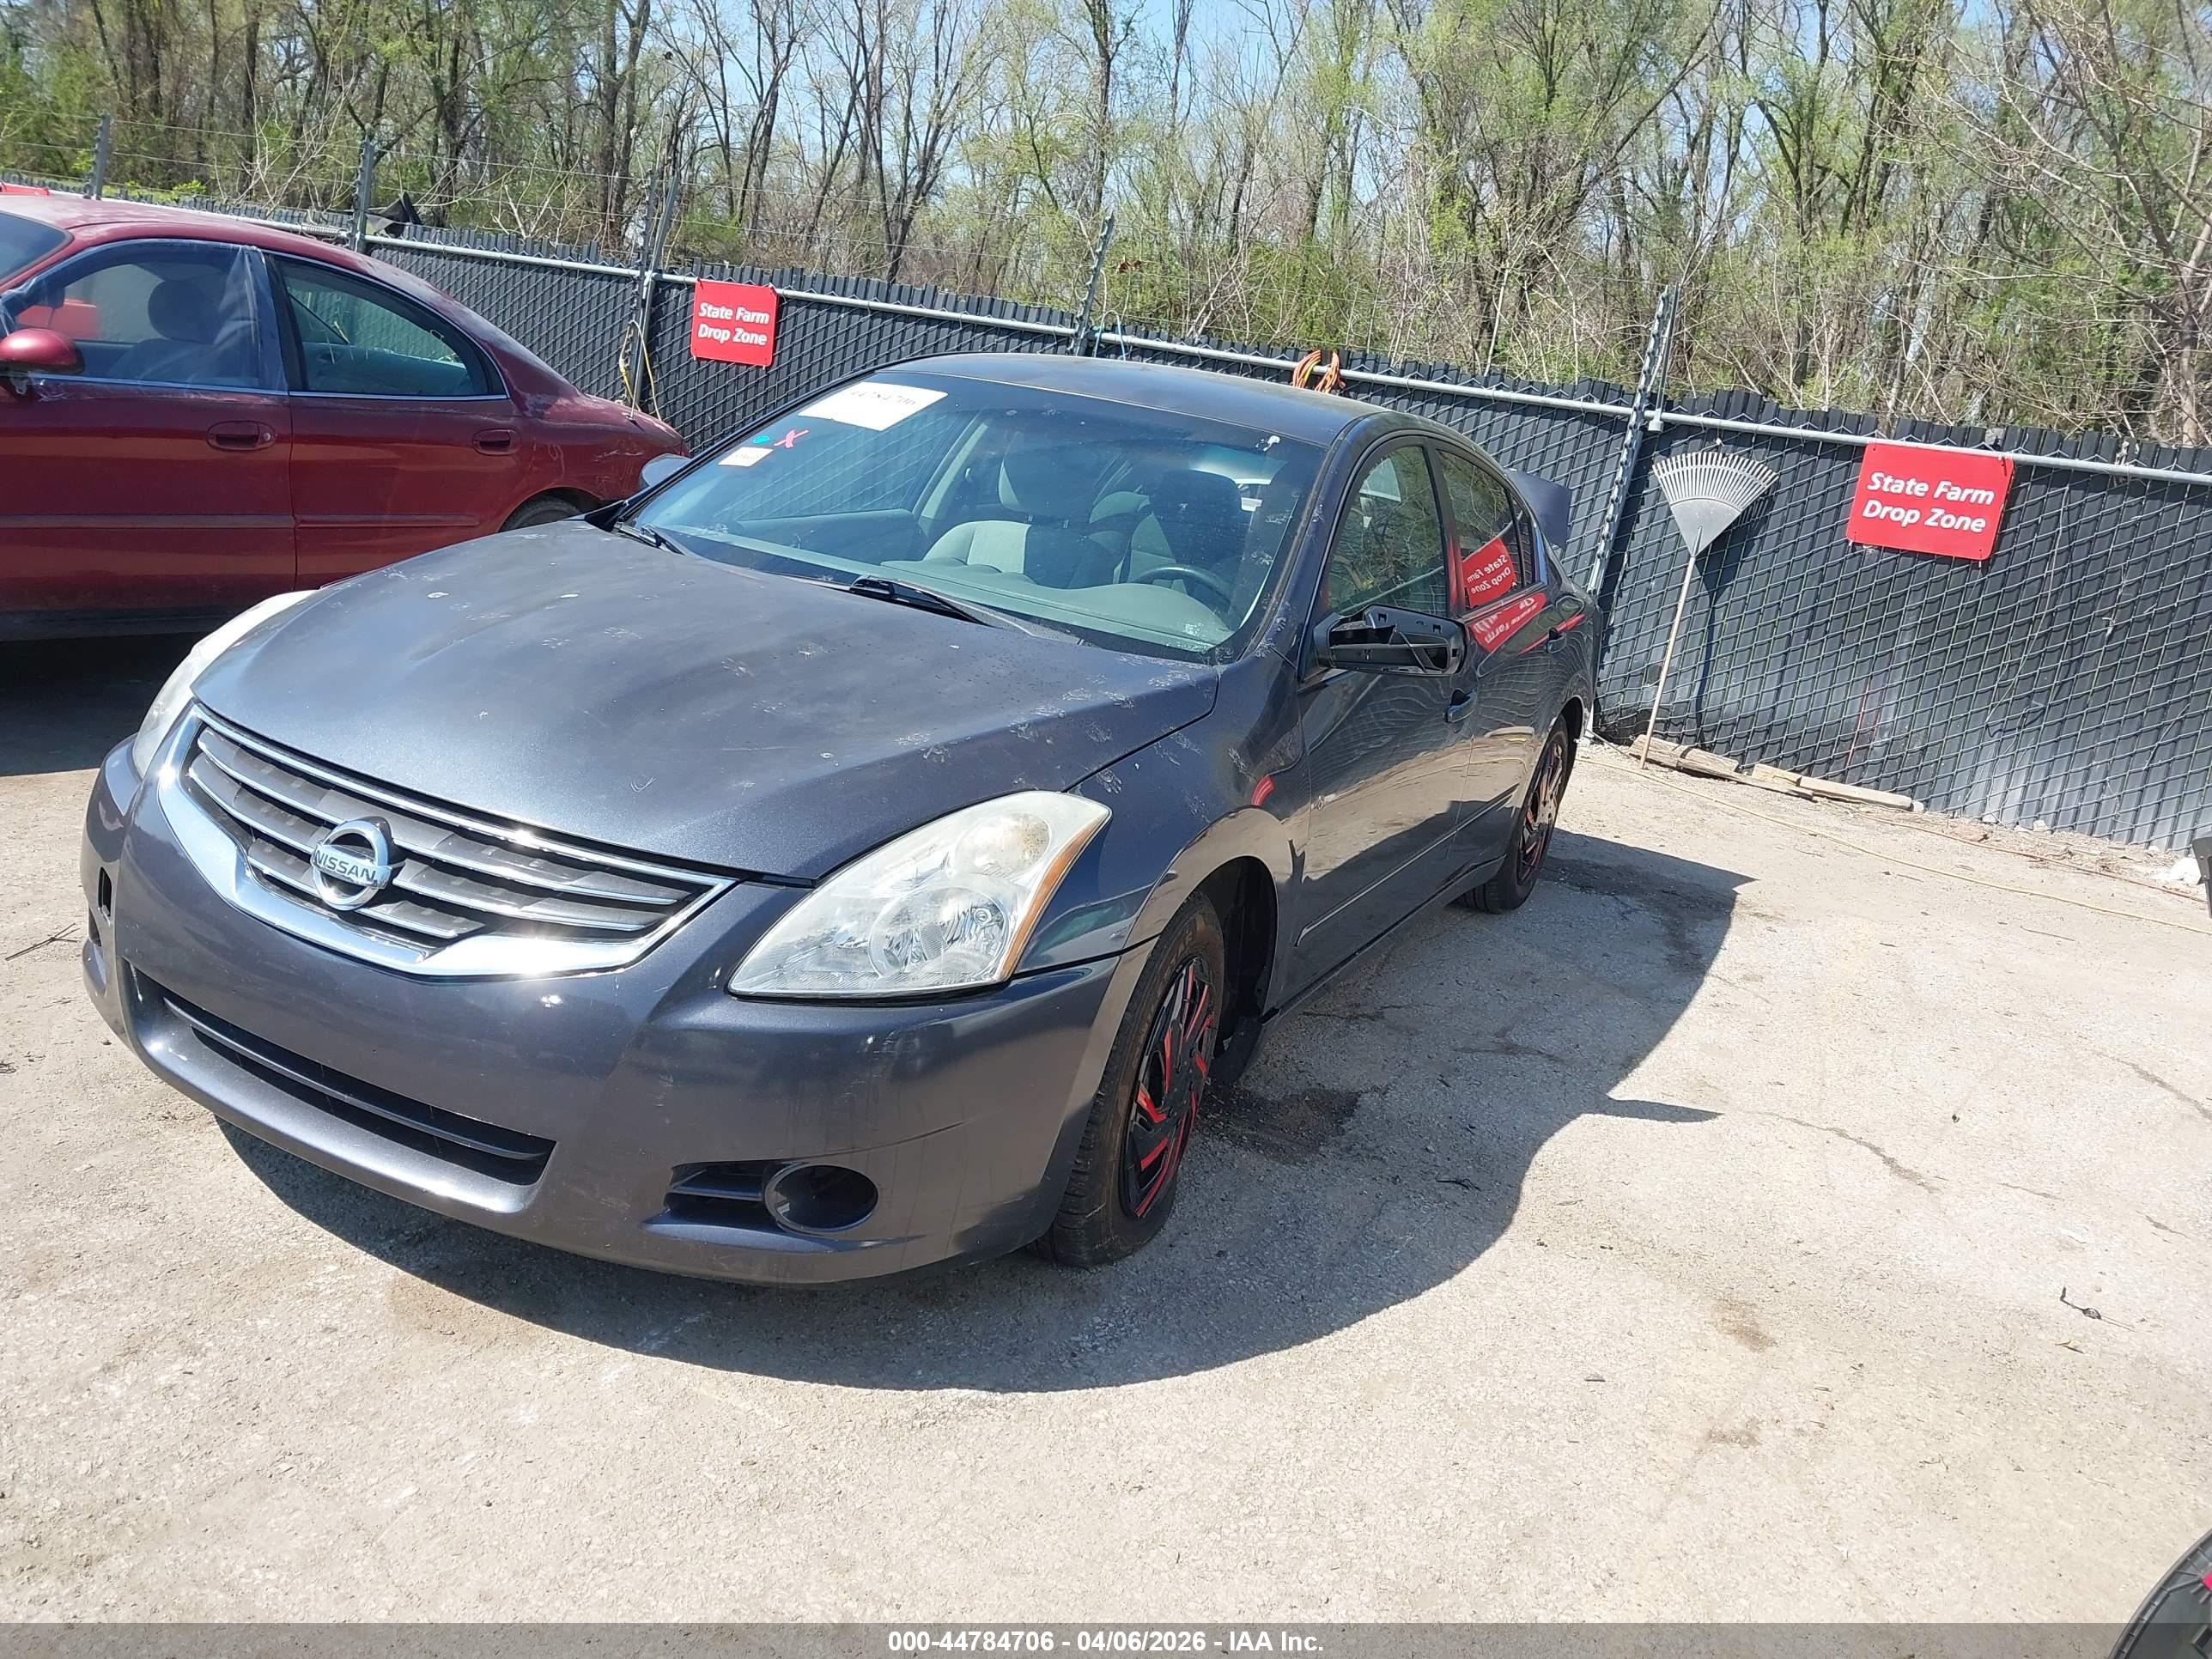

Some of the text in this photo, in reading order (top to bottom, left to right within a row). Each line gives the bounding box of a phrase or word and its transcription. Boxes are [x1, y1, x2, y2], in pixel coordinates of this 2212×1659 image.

[698, 302, 770, 324] State Farm
[697, 324, 768, 345] Drop Zone
[1867, 472, 1996, 506] State Farm
[1862, 499, 1986, 533] Drop Zone
[315, 849, 376, 882] NISSAN
